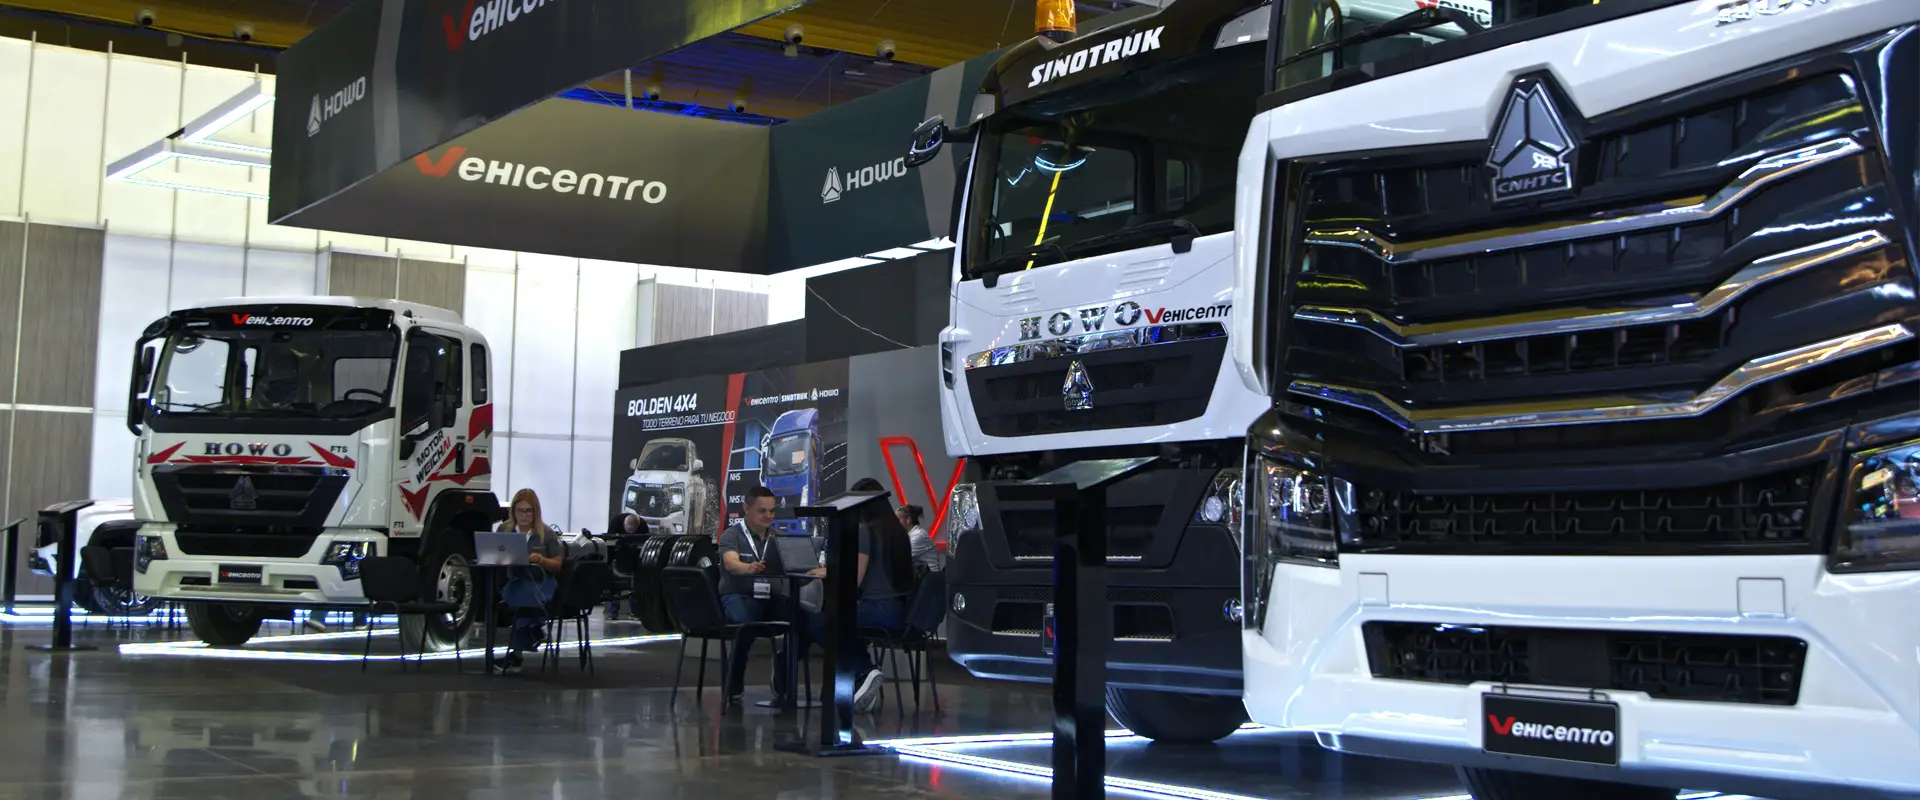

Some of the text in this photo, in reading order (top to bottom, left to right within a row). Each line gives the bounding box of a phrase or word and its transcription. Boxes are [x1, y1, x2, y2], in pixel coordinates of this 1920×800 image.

[1027, 25, 1165, 88] SINOTRUK
[324, 76, 366, 120] HOWO
[846, 156, 907, 191] HOWO
[1497, 172, 1564, 193] CNHTC
[1019, 301, 1142, 340] HOWO
[627, 392, 698, 417] BOLDEN 4X4
[781, 391, 808, 403] SINOTRUK
[819, 388, 839, 398] HOWO
[642, 410, 736, 429] TODO TERRENO PARA TU NEGOCIO
[203, 441, 293, 457] HOWO
[330, 445, 349, 453] FTS
[416, 429, 444, 467] MOTOR
[415, 436, 452, 485] WEICHAI
[729, 472, 741, 481] NHS
[729, 495, 740, 504] NHS
